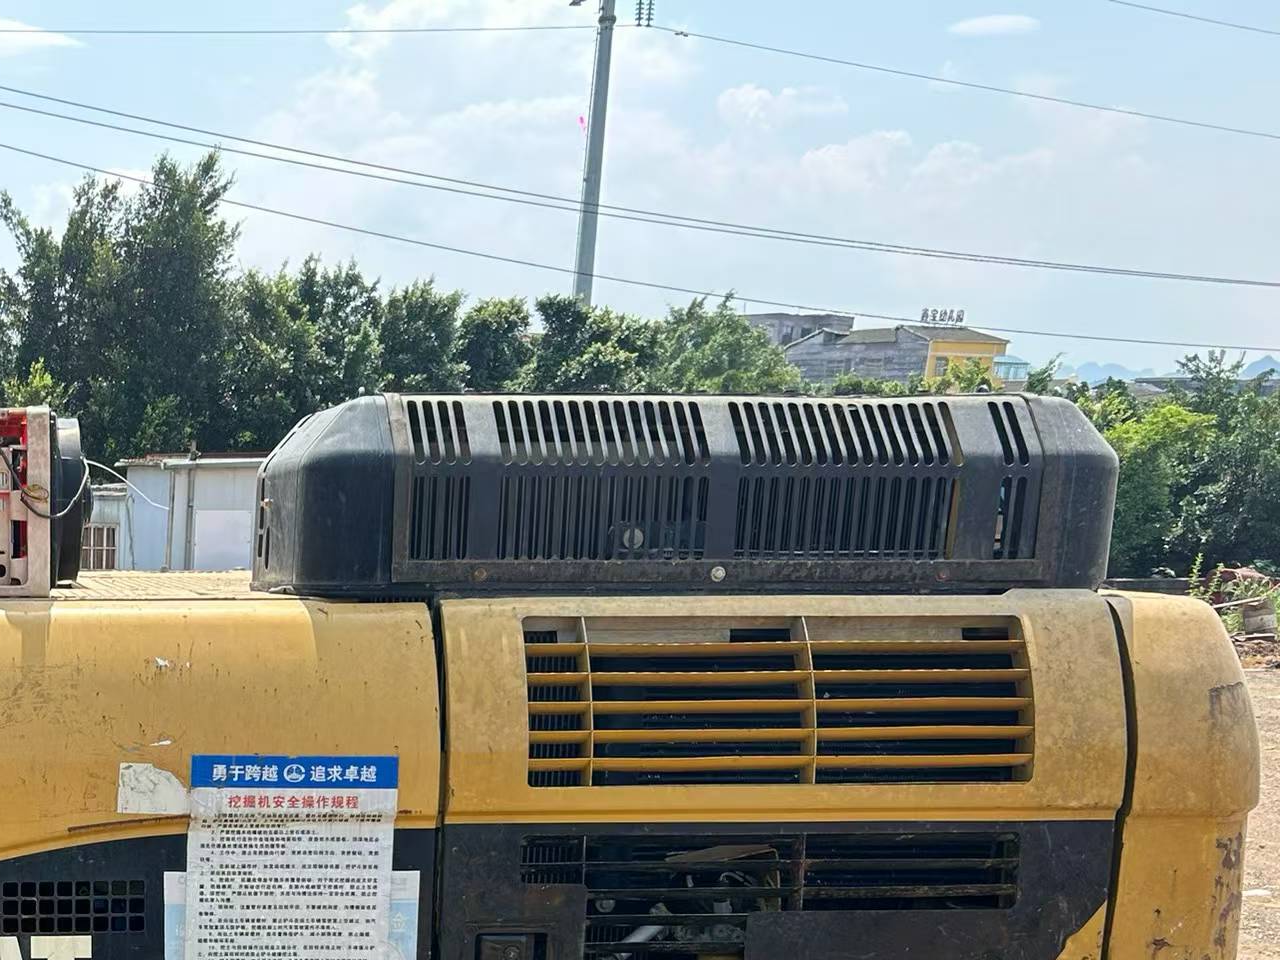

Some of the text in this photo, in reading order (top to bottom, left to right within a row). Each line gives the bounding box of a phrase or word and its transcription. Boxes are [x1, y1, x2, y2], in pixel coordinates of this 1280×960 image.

[212, 764, 377, 783] 勇于跨越 追求卓越
[228, 795, 359, 809] 挖掘机安全操作规程
